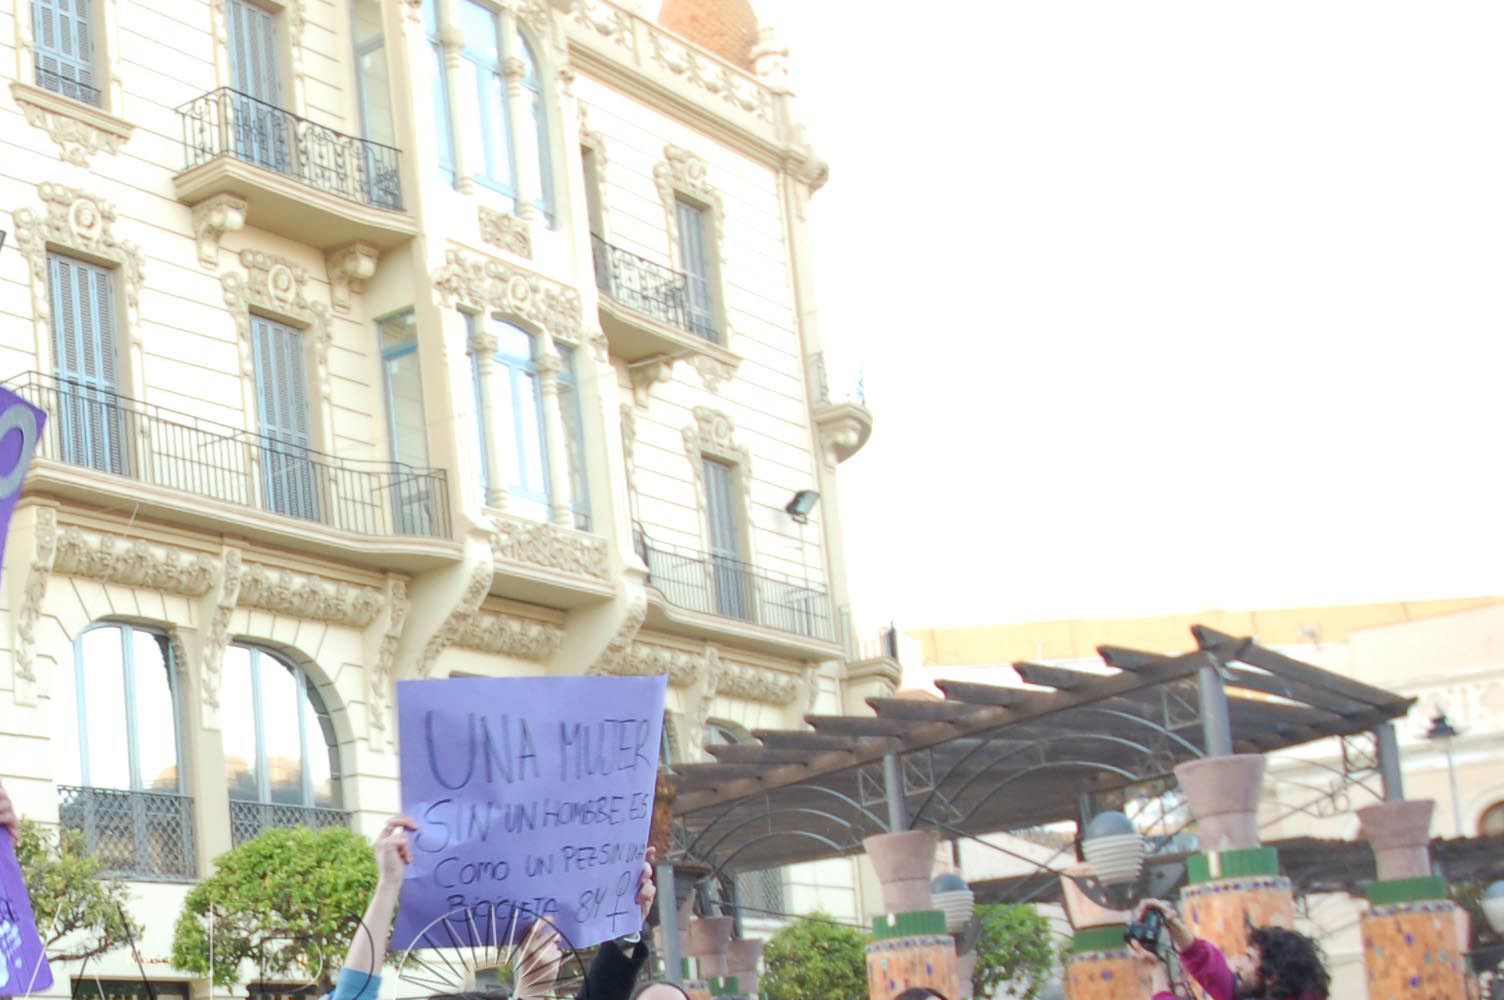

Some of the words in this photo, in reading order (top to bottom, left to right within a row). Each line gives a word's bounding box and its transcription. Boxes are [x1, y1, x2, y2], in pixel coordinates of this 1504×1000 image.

[425, 709, 540, 790] UNA
[559, 717, 651, 782] MUJER
[414, 797, 495, 853] SIN
[505, 803, 535, 833] UN
[545, 796, 623, 831] HOMBRE
[629, 792, 649, 822] ES
[526, 854, 553, 878] UN
